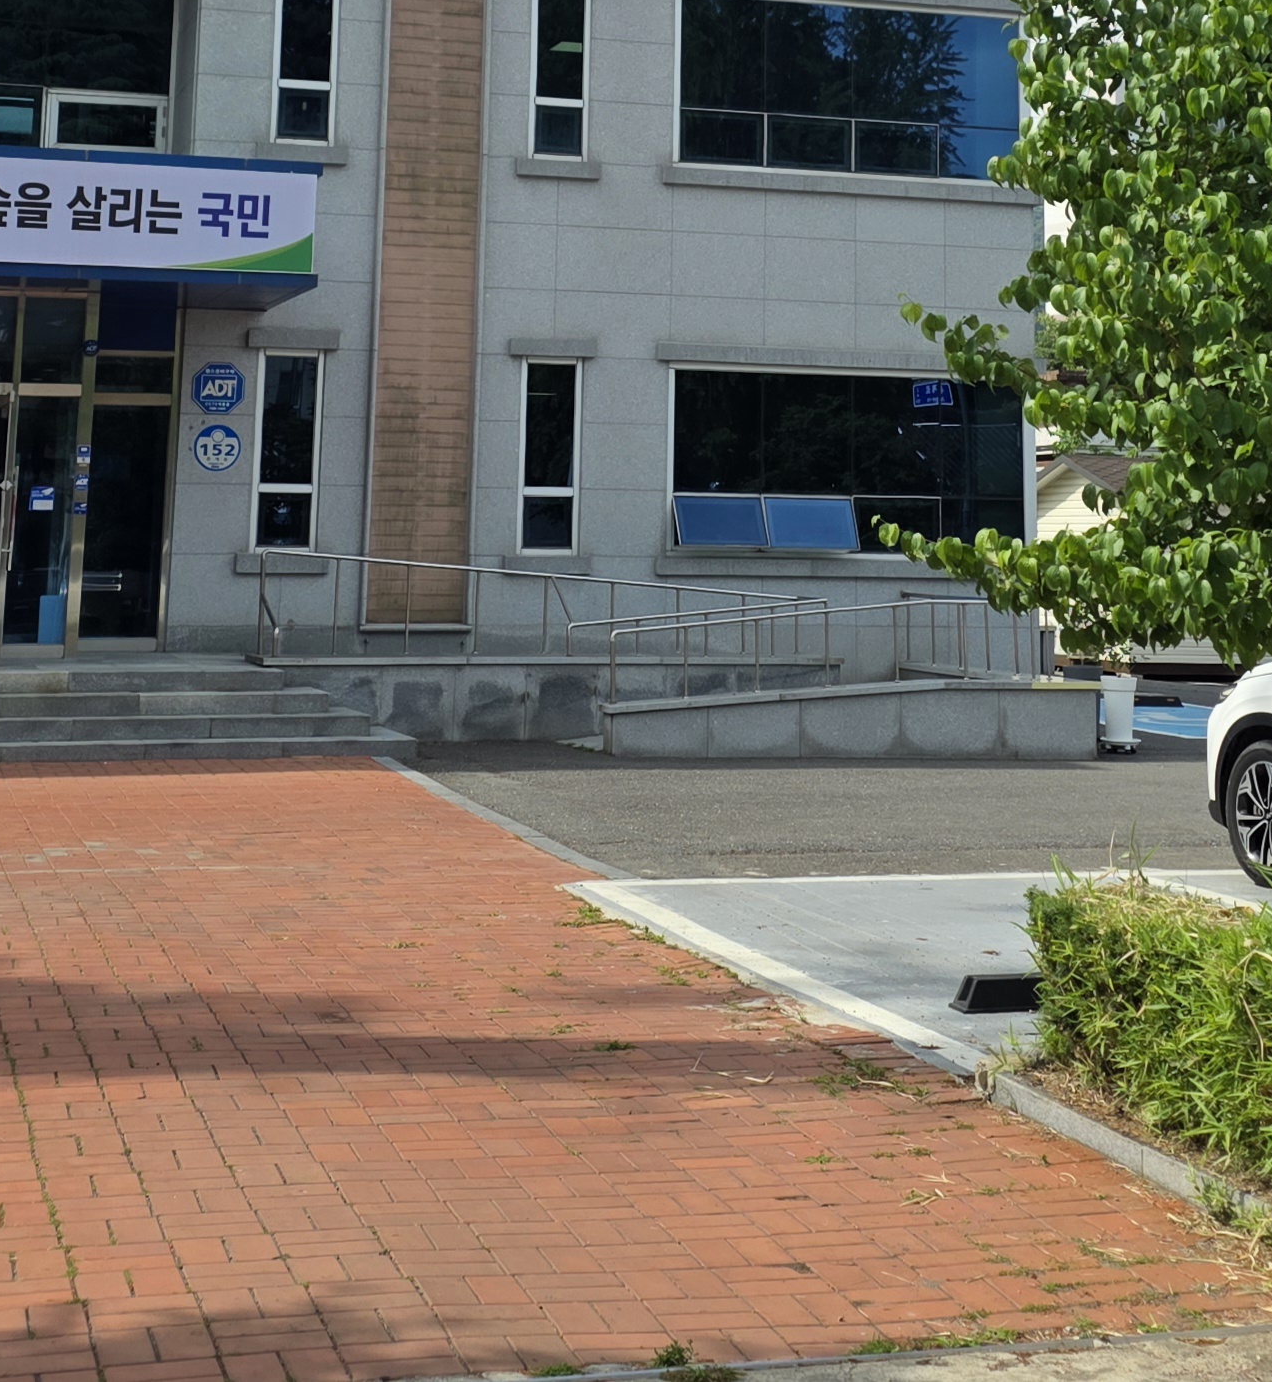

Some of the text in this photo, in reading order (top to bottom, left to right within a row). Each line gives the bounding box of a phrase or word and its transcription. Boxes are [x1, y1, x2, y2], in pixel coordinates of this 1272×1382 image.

[67, 184, 183, 235] 살리는
[198, 190, 271, 239] 국민
[201, 379, 236, 397] ADT
[200, 443, 235, 456] 152
